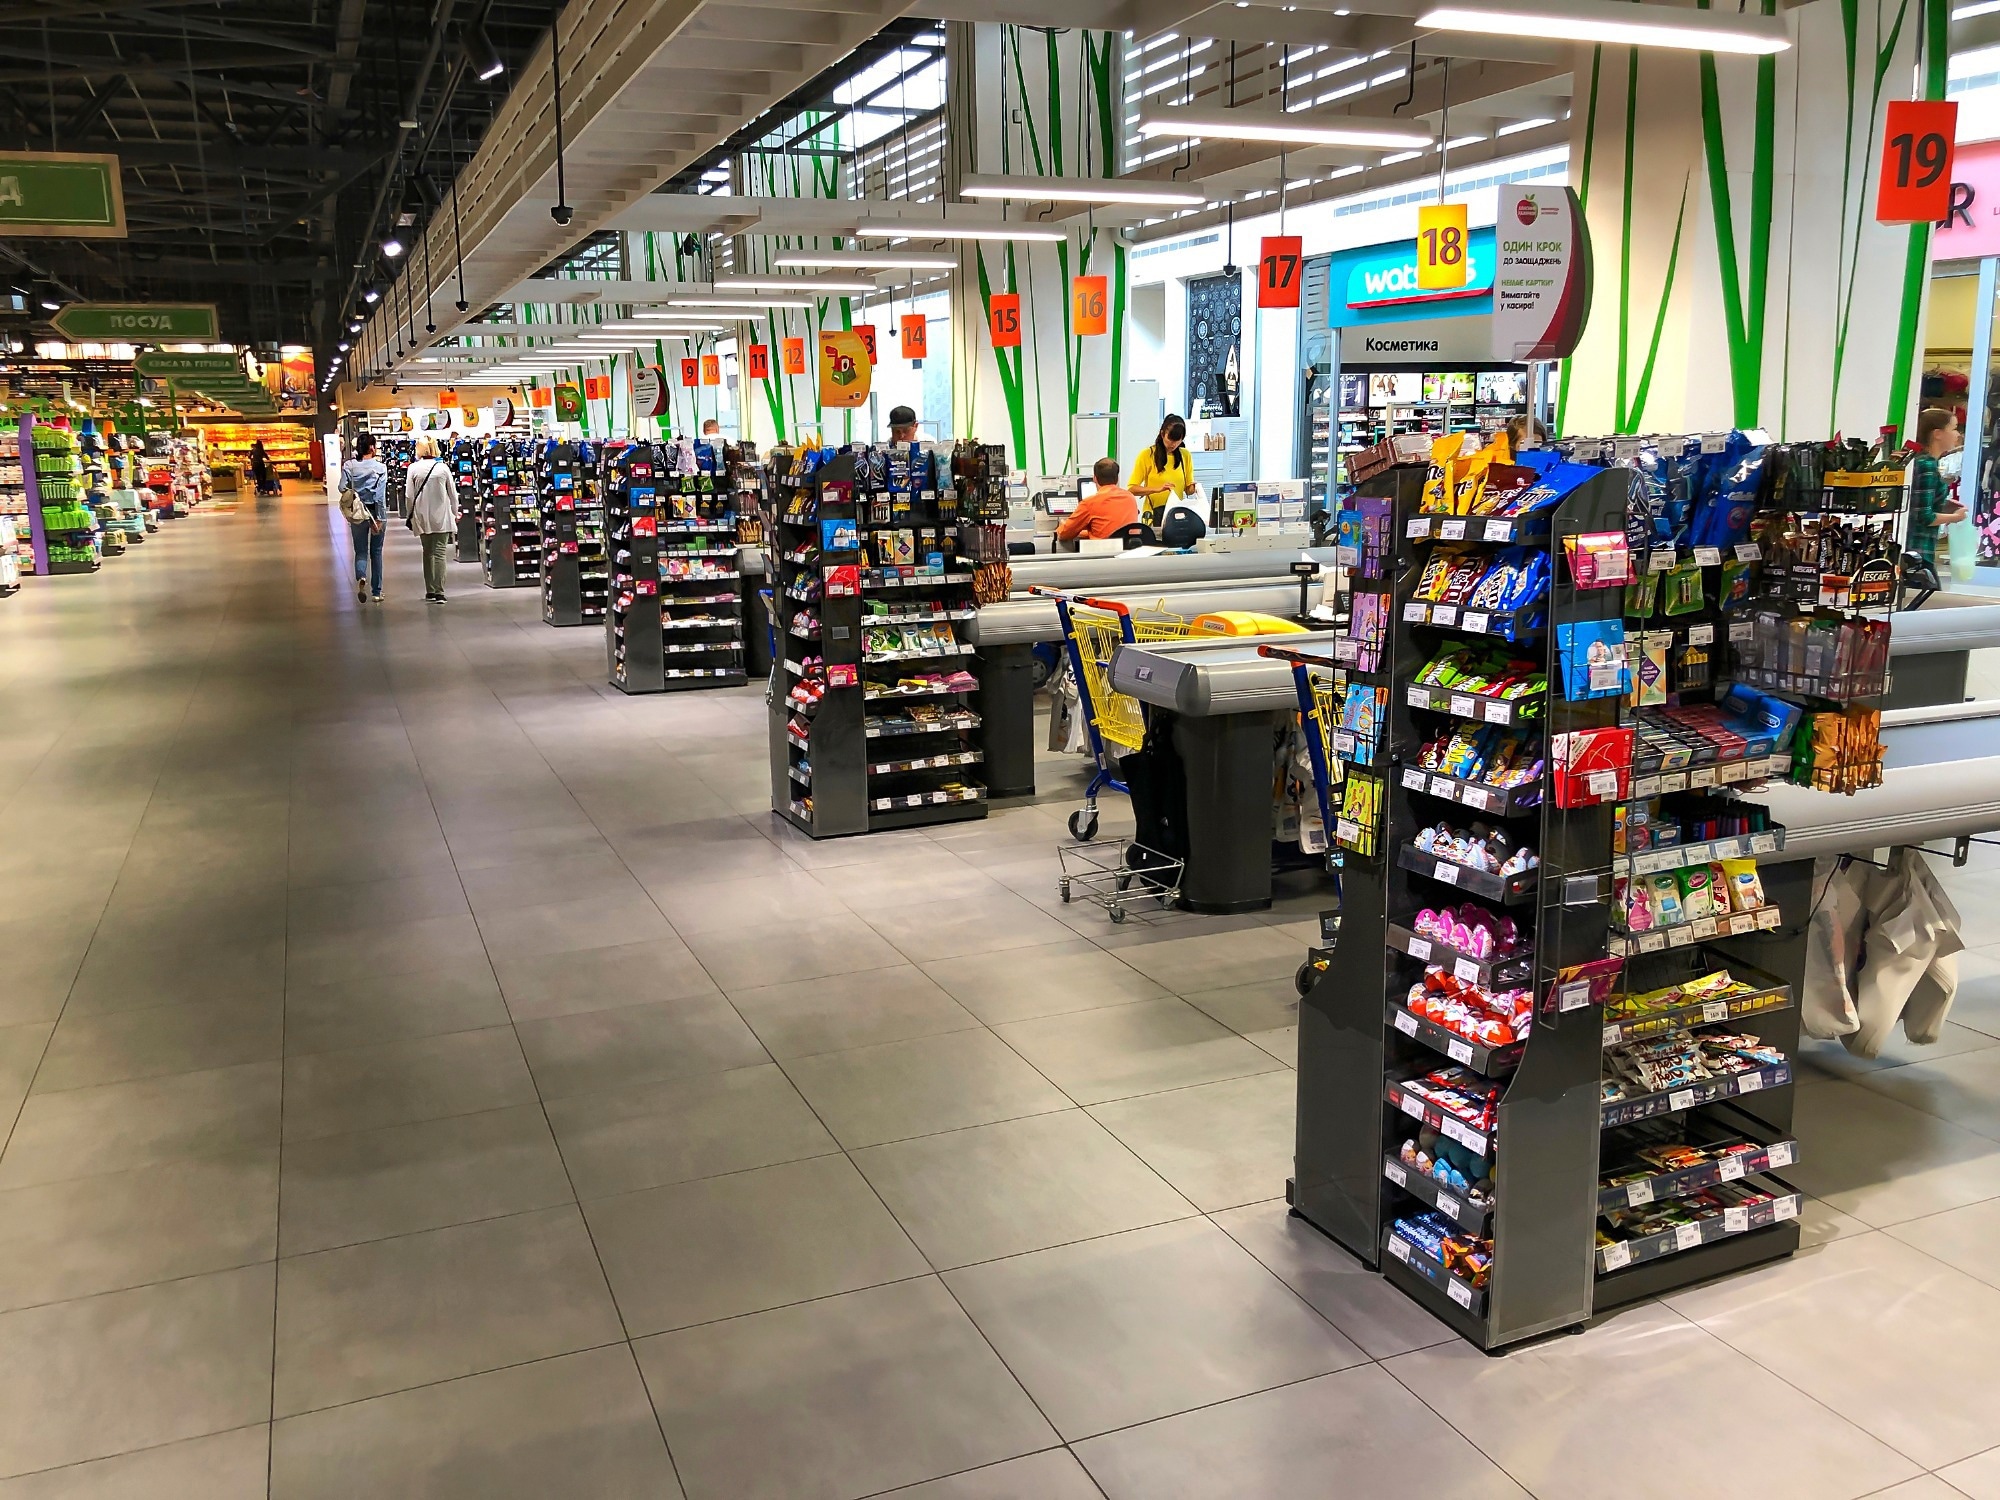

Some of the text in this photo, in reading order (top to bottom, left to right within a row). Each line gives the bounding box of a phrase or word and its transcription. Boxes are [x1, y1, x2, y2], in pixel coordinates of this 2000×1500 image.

[1891, 133, 1947, 188] 19
[1422, 227, 1462, 266] 18
[1503, 241, 1562, 253] ОДИН КРОК
[1264, 255, 1297, 288] 17
[1501, 291, 1540, 299] Вимагайте
[1077, 291, 1104, 318] 16
[1507, 302, 1534, 310] касира!
[110, 315, 173, 330] ПОСУД
[994, 309, 1018, 332] 15
[903, 326, 924, 346] 14
[1366, 337, 1438, 351] Косметика
[752, 353, 766, 369] 11
[785, 348, 802, 364] 12
[686, 365, 694, 379] 9
[704, 364, 718, 377] 10
[589, 384, 595, 394] 5
[1869, 474, 1898, 485] JACOBS
